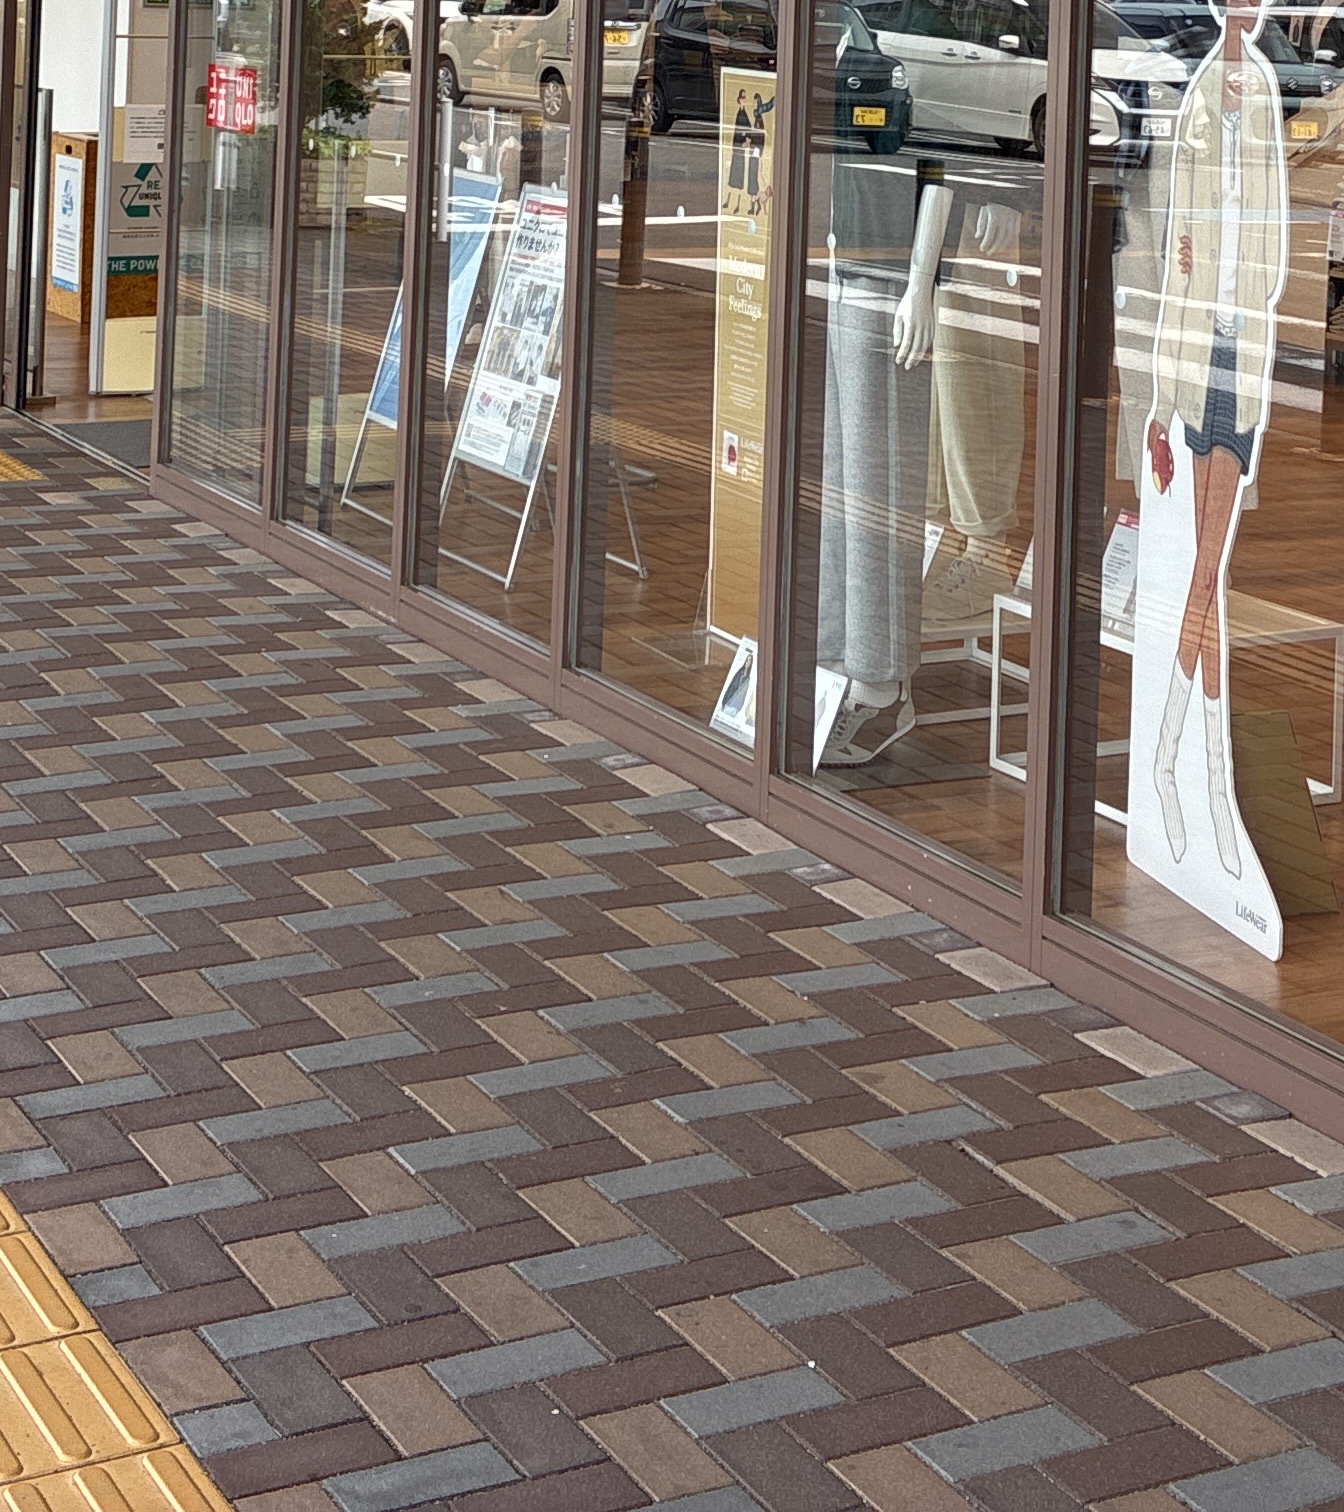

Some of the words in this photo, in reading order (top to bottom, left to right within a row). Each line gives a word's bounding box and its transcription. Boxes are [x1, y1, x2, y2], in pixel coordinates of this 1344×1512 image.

[130, 258, 159, 271] POW
[736, 277, 755, 301] City
[728, 294, 763, 322] Feelings
[1235, 900, 1268, 935] LifeWear
